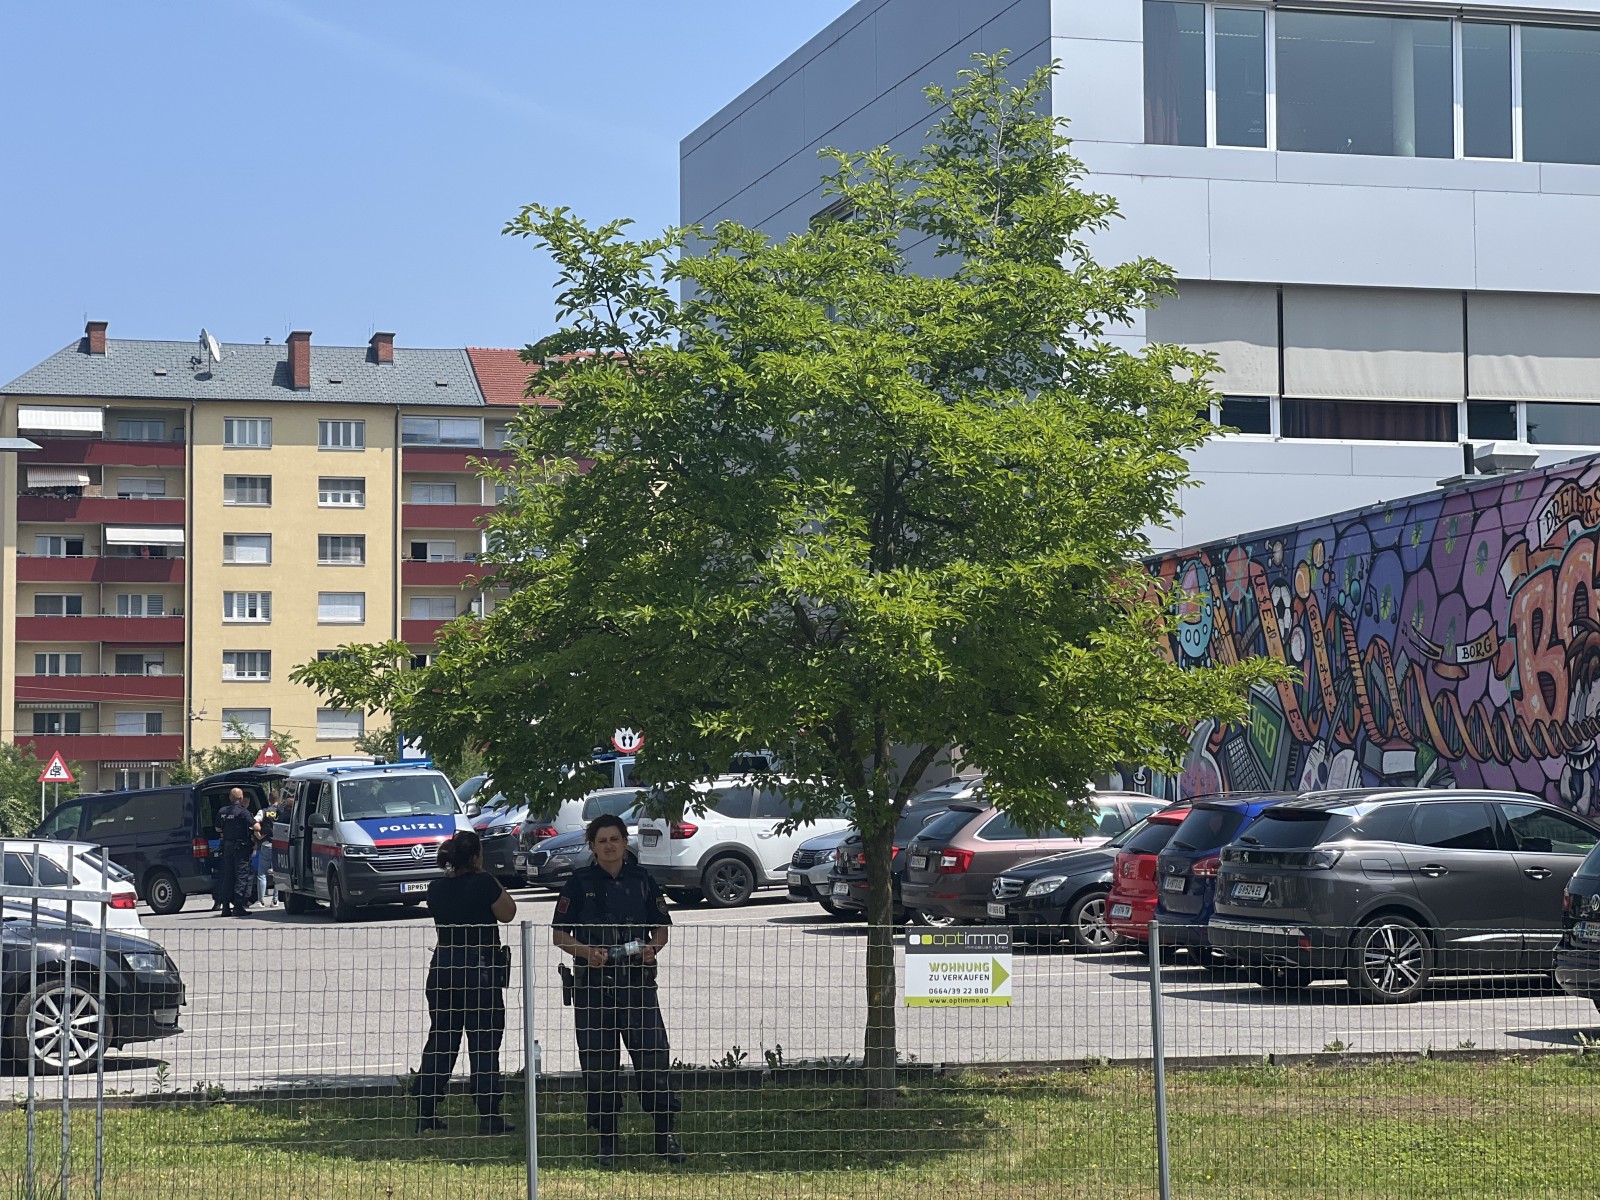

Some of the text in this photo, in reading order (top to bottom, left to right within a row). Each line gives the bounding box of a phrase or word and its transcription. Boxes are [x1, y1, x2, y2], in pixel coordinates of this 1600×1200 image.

[1462, 636, 1493, 659] BORG
[1252, 706, 1277, 759] NEO
[379, 823, 443, 833] POLIZEI
[933, 931, 1009, 947] optimmo
[928, 962, 990, 973] WOHNUNG
[928, 987, 961, 995] 0664/39
